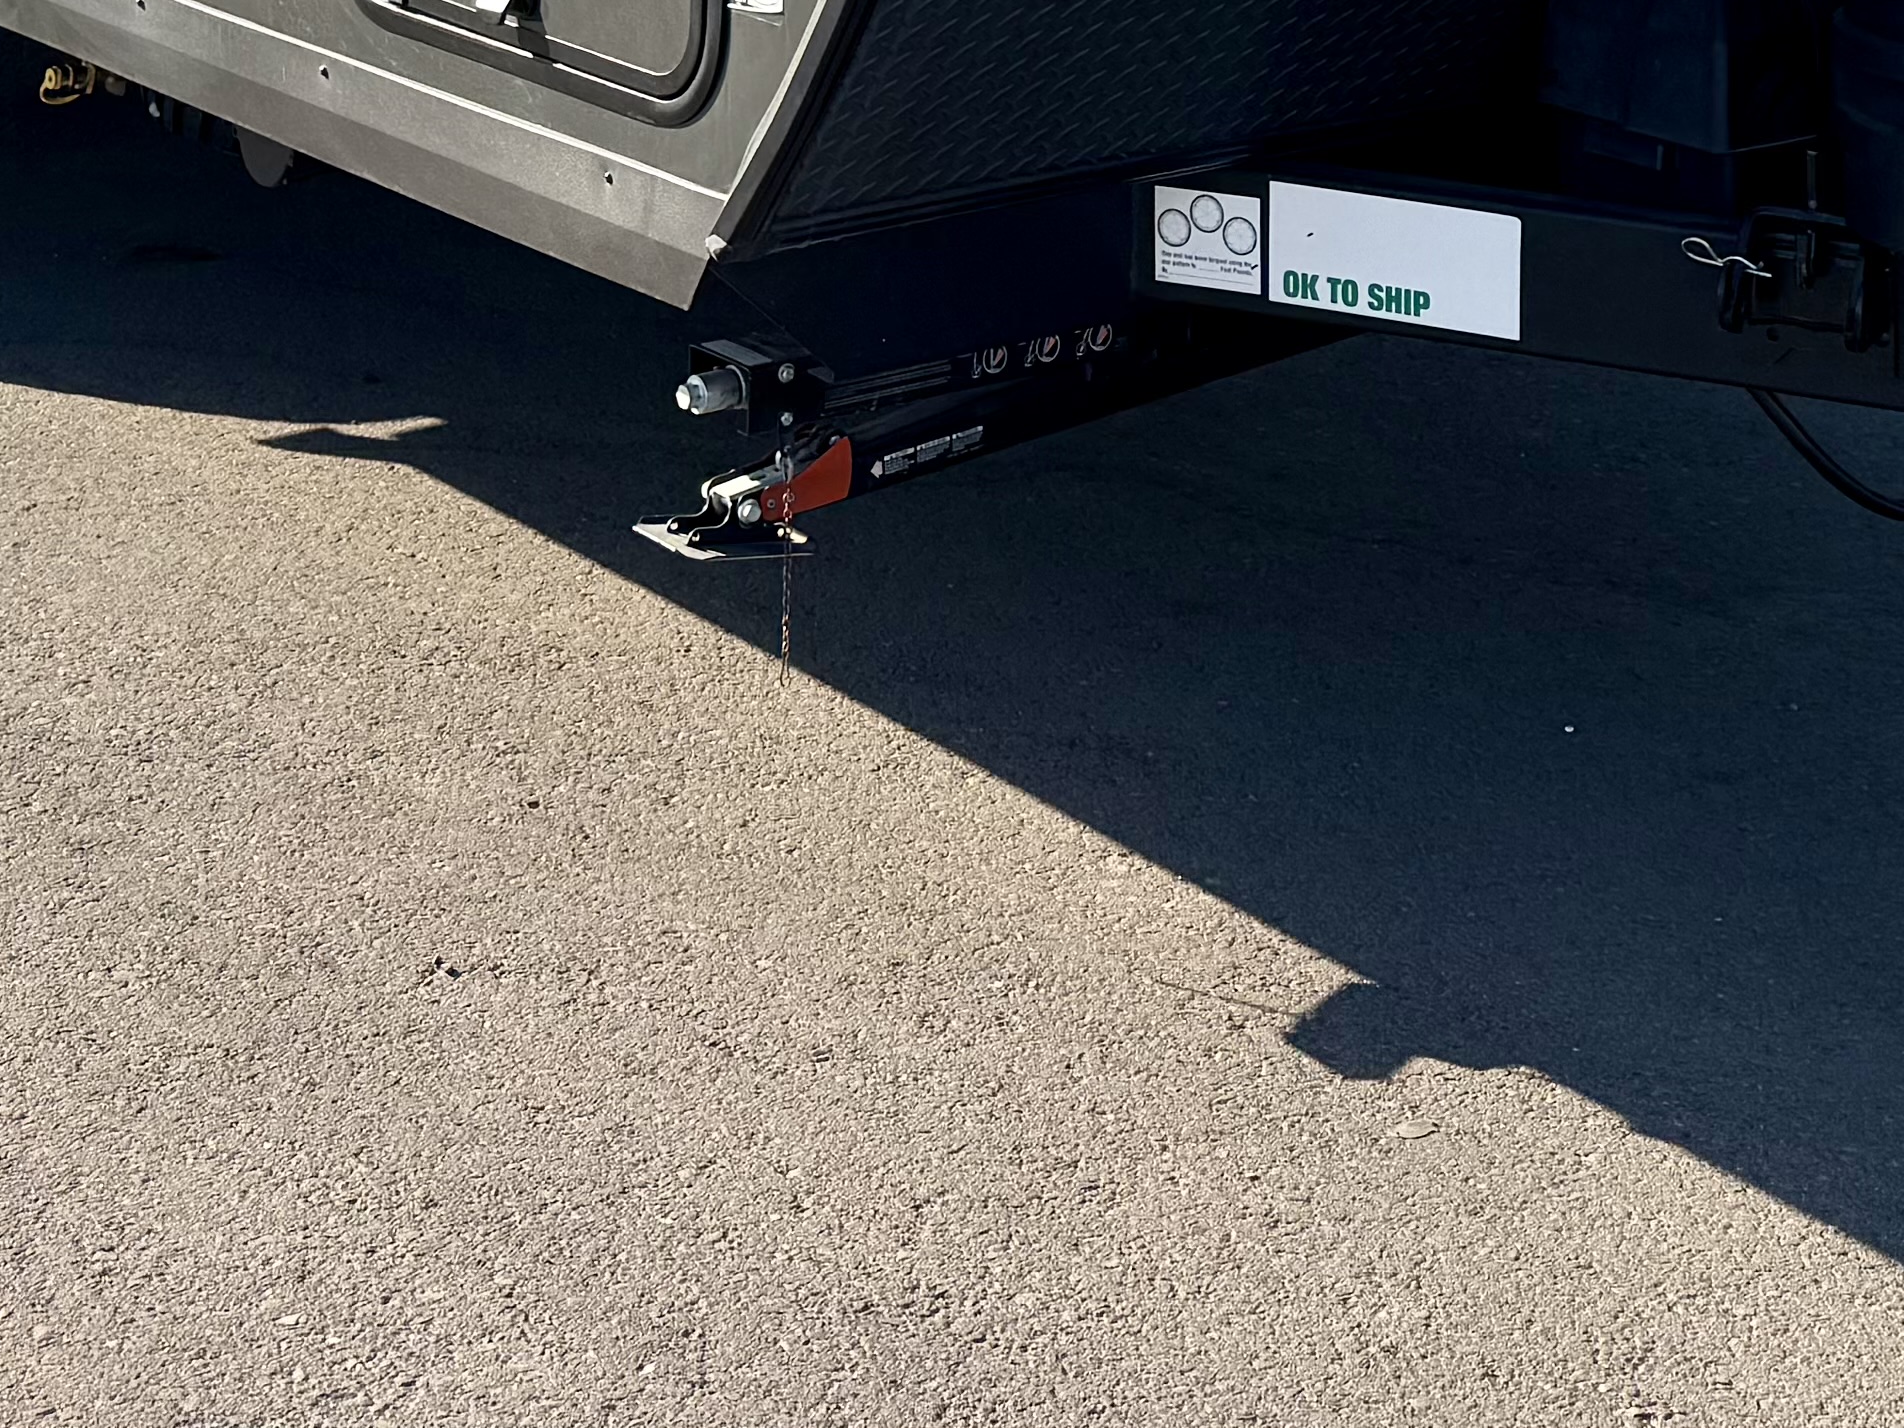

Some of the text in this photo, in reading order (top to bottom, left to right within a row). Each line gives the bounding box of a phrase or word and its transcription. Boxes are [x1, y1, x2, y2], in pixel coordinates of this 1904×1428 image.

[1283, 269, 1432, 318] OK TO SHIP
